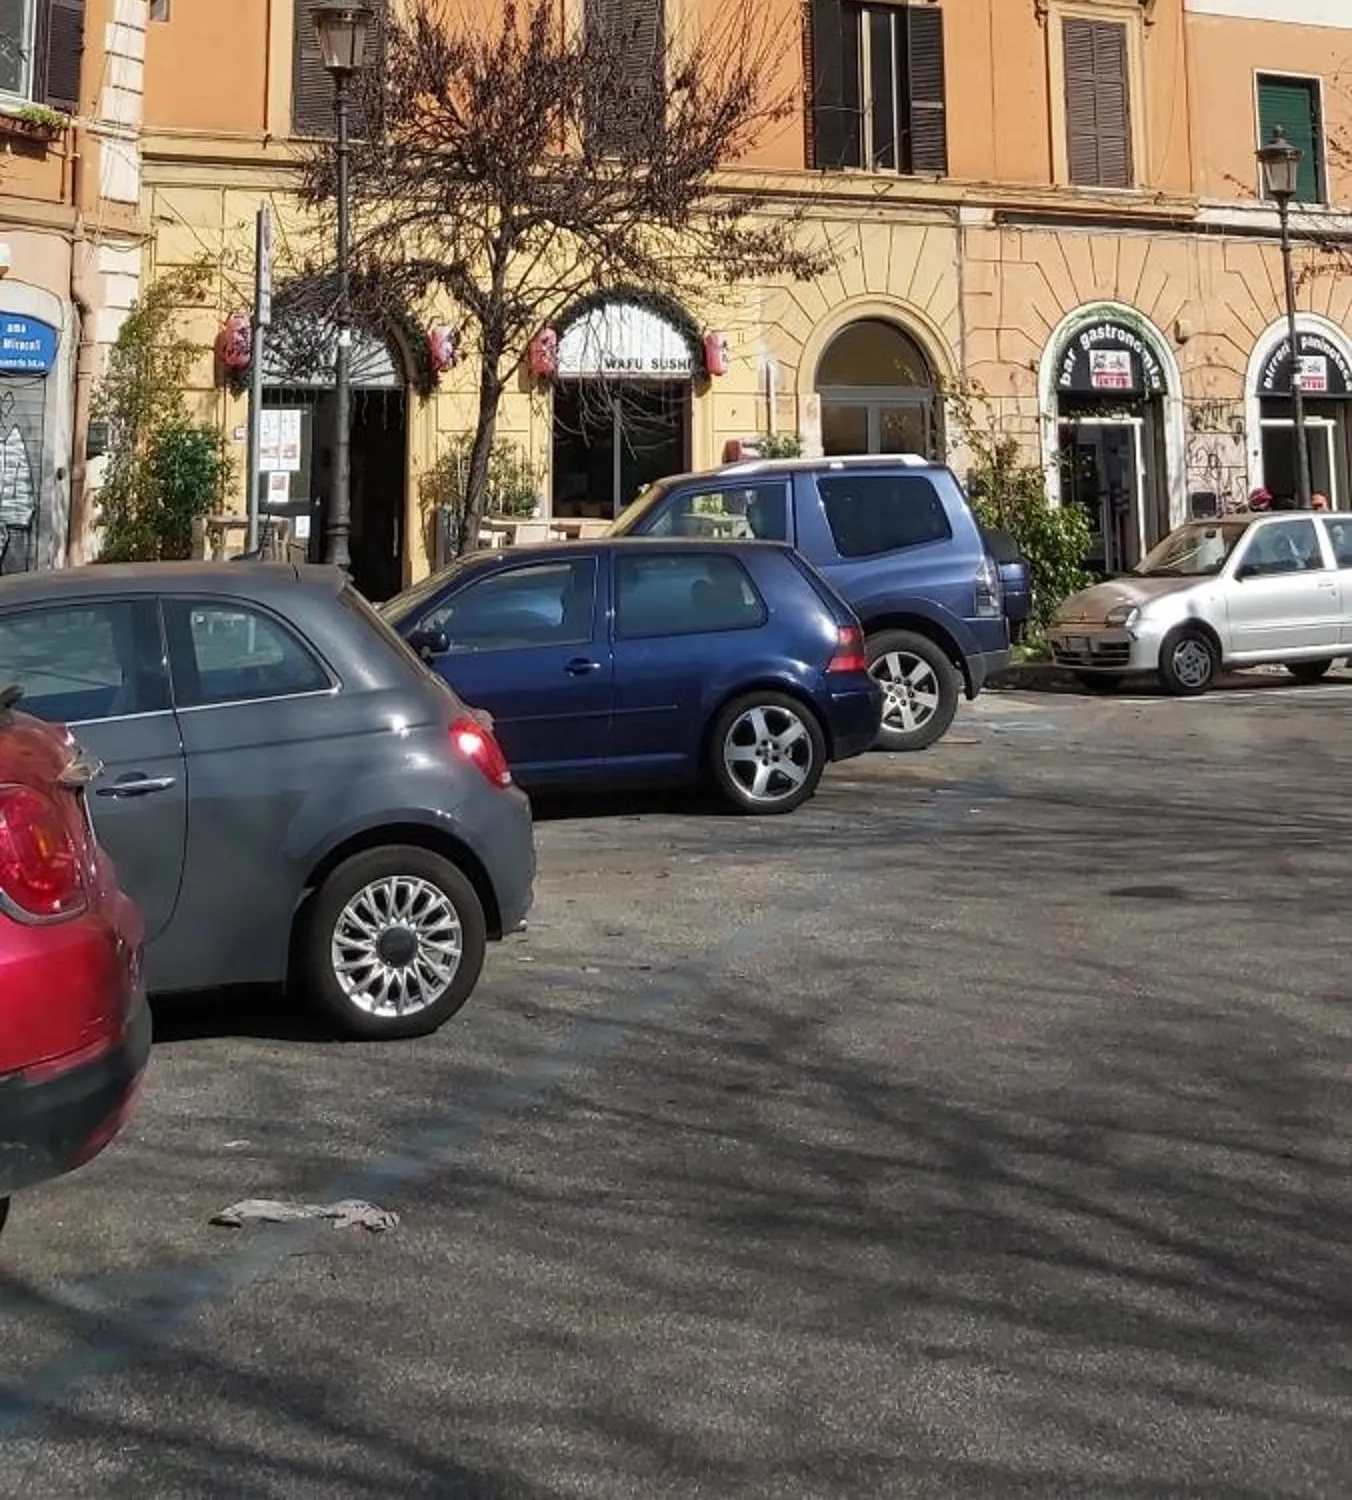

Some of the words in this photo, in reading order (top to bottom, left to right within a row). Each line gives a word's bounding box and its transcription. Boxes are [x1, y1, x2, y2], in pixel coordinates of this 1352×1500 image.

[604, 357, 643, 370] WAFU
[651, 357, 691, 371] SUSHI
[1060, 347, 1077, 387] bar
[1263, 339, 1292, 389] birreri
